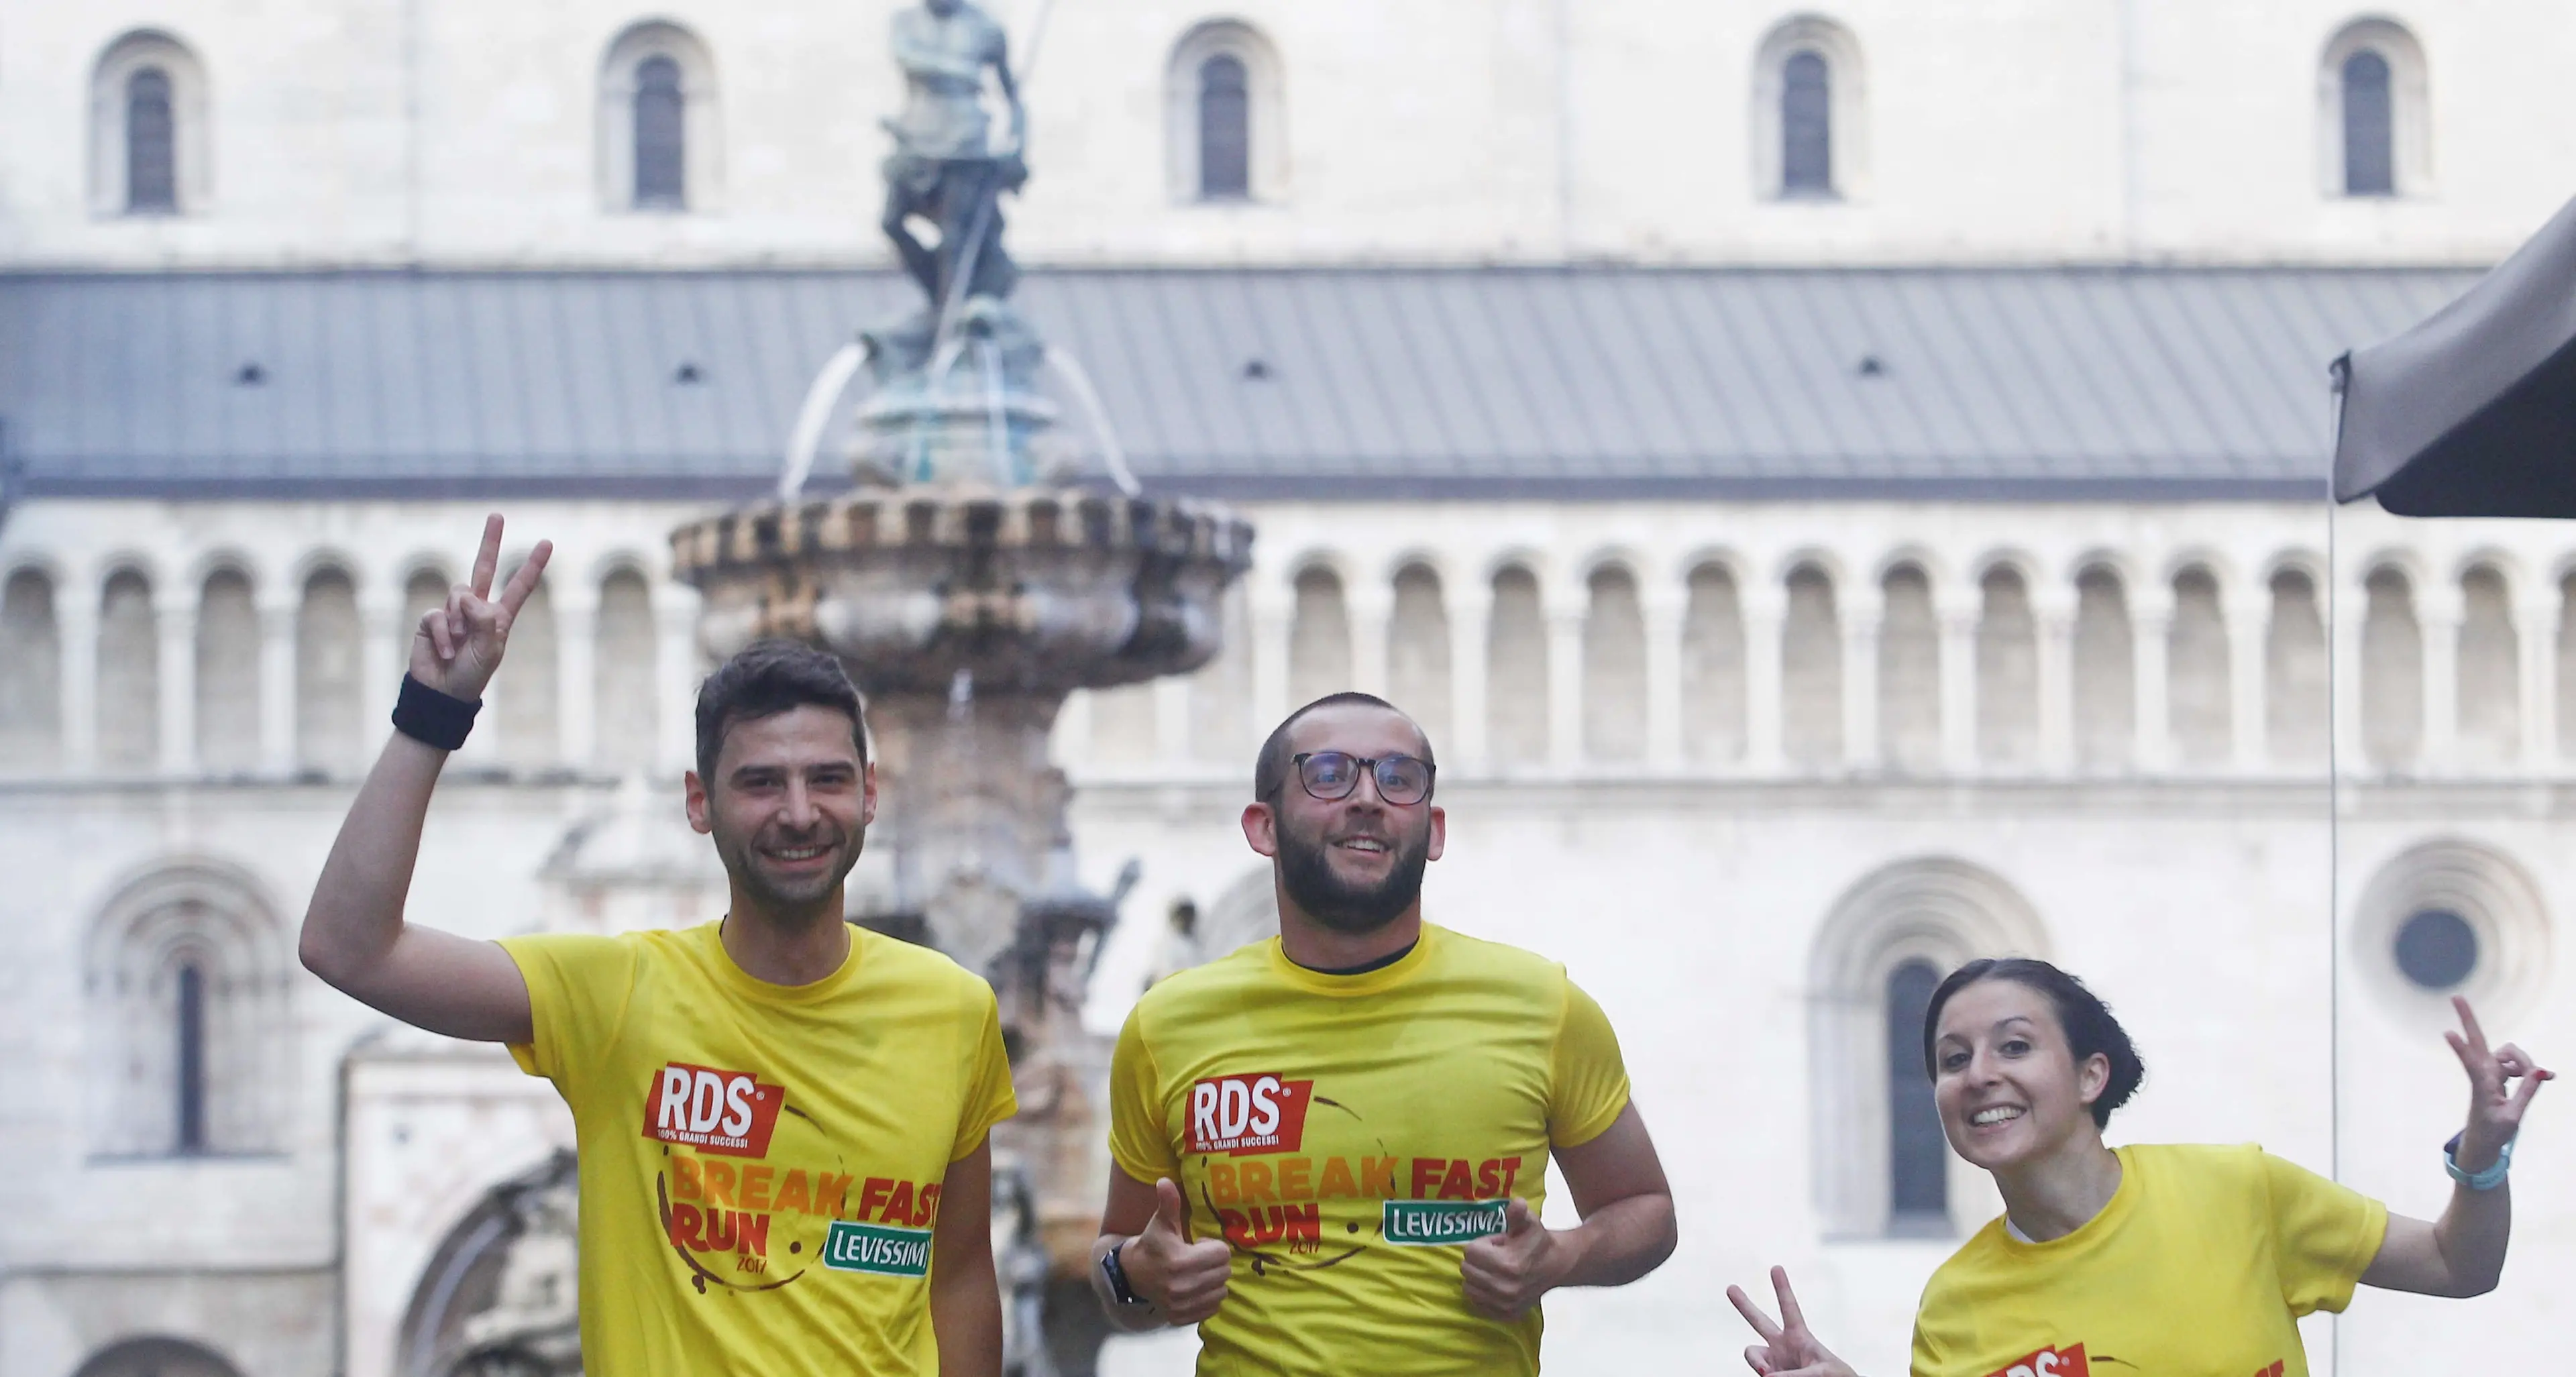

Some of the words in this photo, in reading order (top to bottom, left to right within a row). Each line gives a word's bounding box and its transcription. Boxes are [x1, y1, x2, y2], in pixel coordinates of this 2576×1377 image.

[679, 1132, 707, 1144] GRANDI
[710, 1136, 748, 1148] SUCCESSI
[1214, 1138, 1239, 1150] GRANDI
[1241, 1135, 1279, 1148] SUCCESSI
[672, 1155, 854, 1218] BREAK
[1210, 1156, 1399, 1205] BREAK
[1411, 1156, 1521, 1201] FAST
[670, 1203, 770, 1257] RUN
[1219, 1203, 1320, 1248] RUN
[1393, 1205, 1507, 1237] LEVISSIMA
[737, 1257, 767, 1274] 2017
